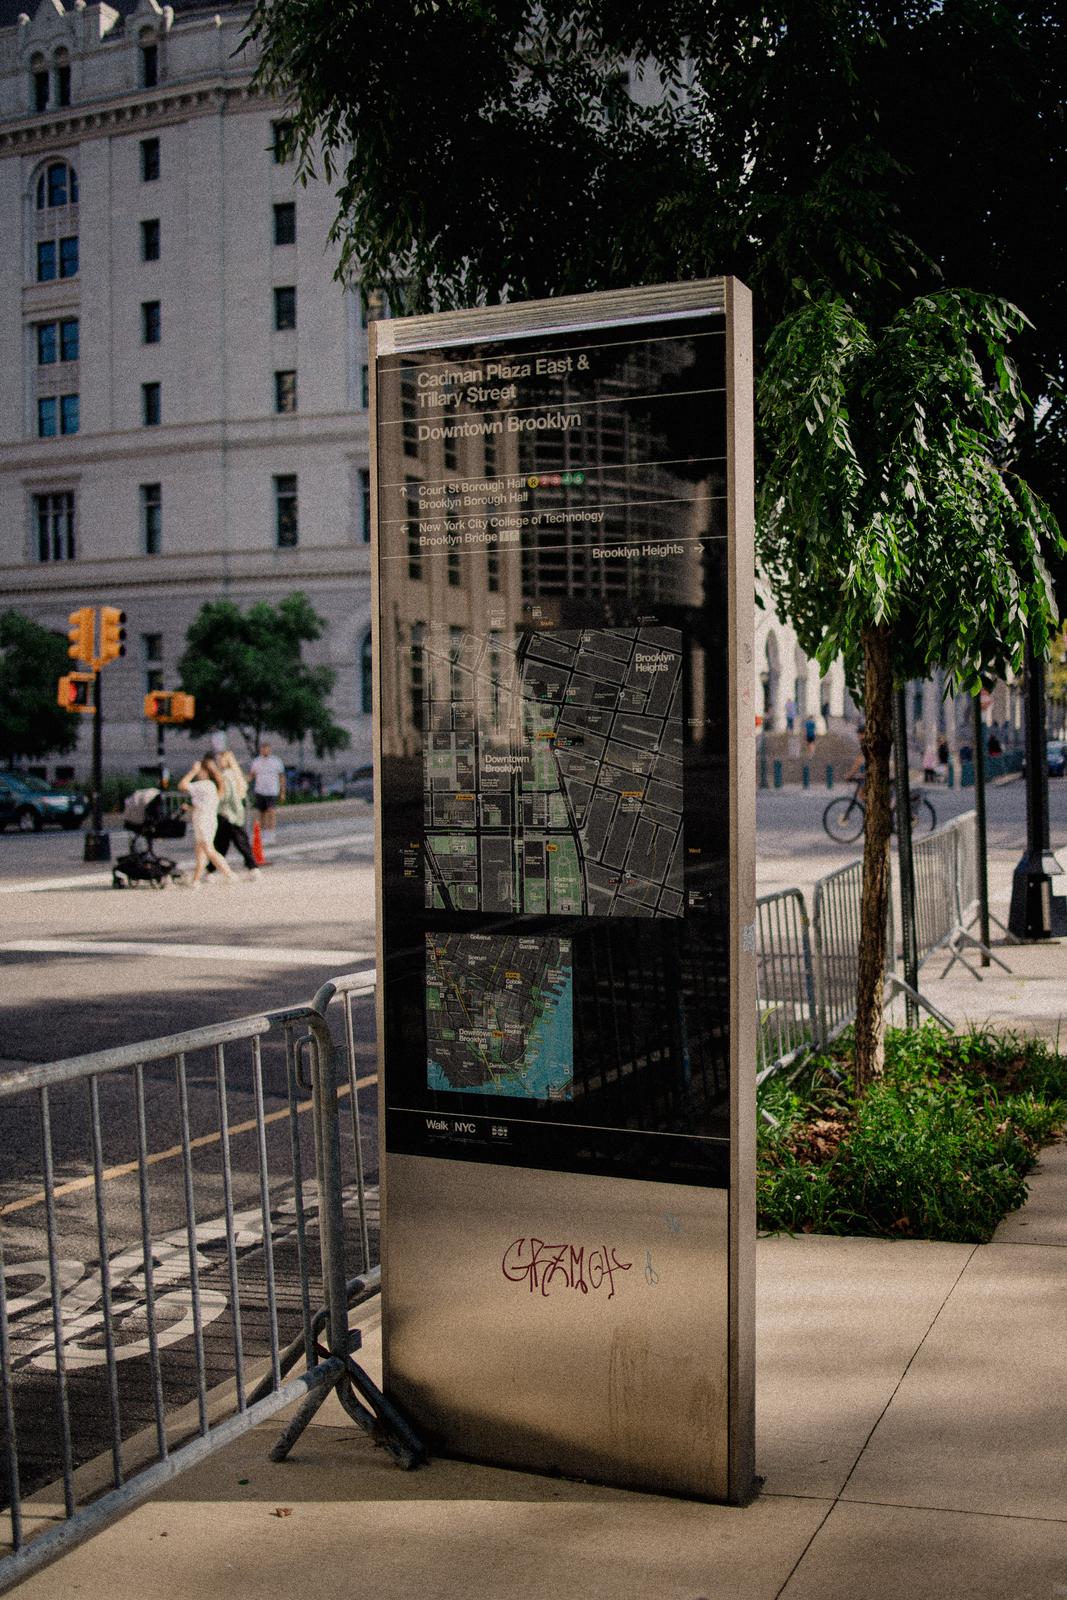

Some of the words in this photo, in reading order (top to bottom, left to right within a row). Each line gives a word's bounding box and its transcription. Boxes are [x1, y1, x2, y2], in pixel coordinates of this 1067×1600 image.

[417, 369, 483, 388] Cadman
[486, 362, 531, 379] Plaza
[535, 357, 573, 375] East
[577, 354, 590, 370] &
[417, 389, 463, 410] Tillary
[466, 383, 517, 402] Street
[418, 421, 503, 441] Downtown
[507, 412, 581, 433] Brooklyn
[419, 485, 447, 497] Court
[448, 484, 460, 494] St
[462, 480, 505, 493] Borough
[507, 478, 526, 489] Hall
[419, 498, 462, 510] Brooklyn
[464, 494, 507, 506] Borough
[509, 492, 529, 502] Hall
[419, 522, 441, 533] New
[444, 520, 465, 531] York
[467, 519, 488, 530] City
[490, 515, 529, 528] College
[531, 514, 542, 524] of
[544, 510, 604, 525] Technology
[419, 535, 463, 546] Brooklyn
[465, 532, 498, 544] Bridge
[592, 545, 639, 560] Brooklyn
[642, 544, 684, 559] Heights
[635, 653, 675, 664] Brooklyn
[635, 663, 669, 673] Heights
[485, 755, 530, 763] Downtown
[485, 764, 522, 774] Brooklyn
[425, 1119, 449, 1131] Walk
[454, 1121, 476, 1133] NYC
